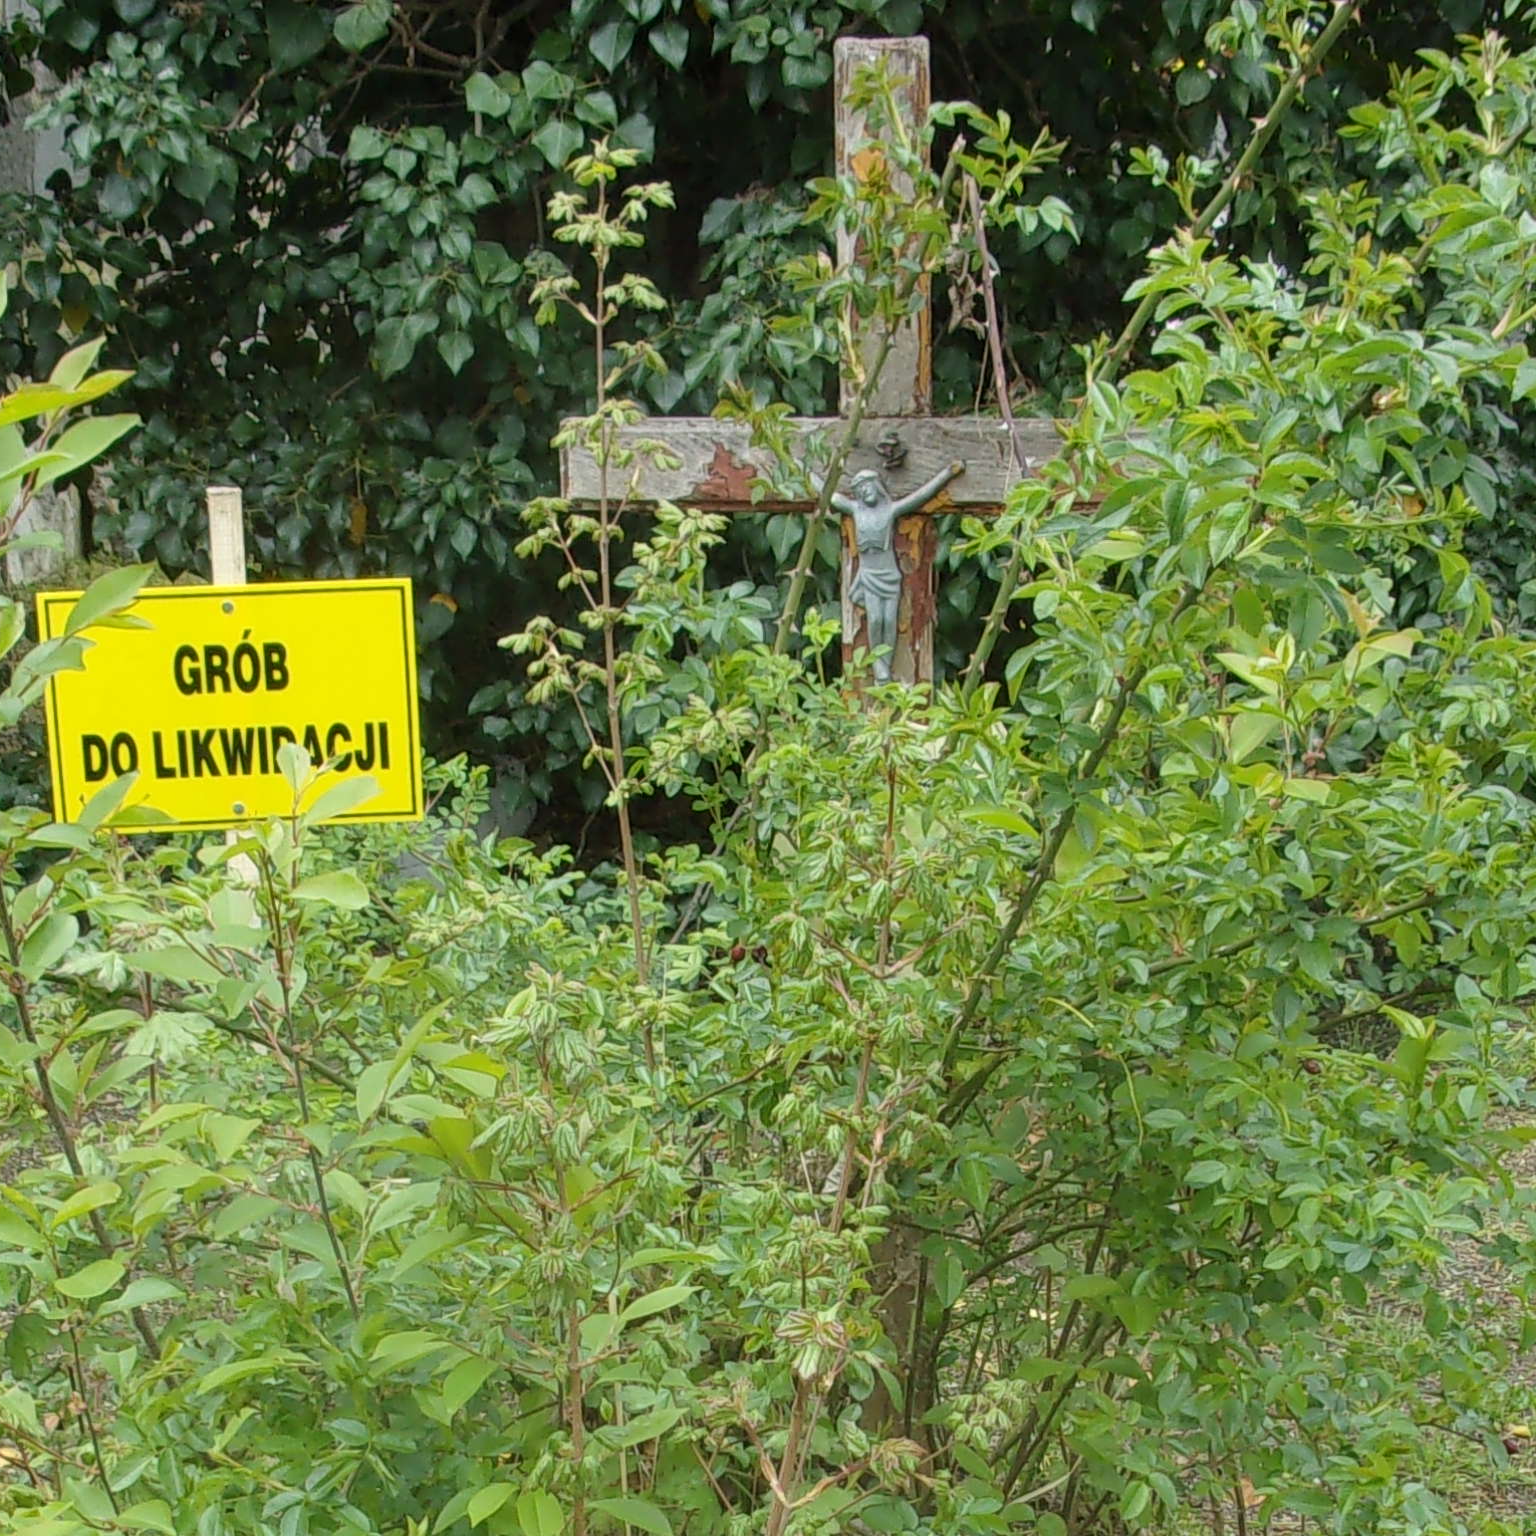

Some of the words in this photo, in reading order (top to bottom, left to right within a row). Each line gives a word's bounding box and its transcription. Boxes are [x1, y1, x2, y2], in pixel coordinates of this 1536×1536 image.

[174, 629, 289, 695] GRÓB
[81, 732, 138, 781] DO
[152, 721, 390, 780] LIKWIDACJI
